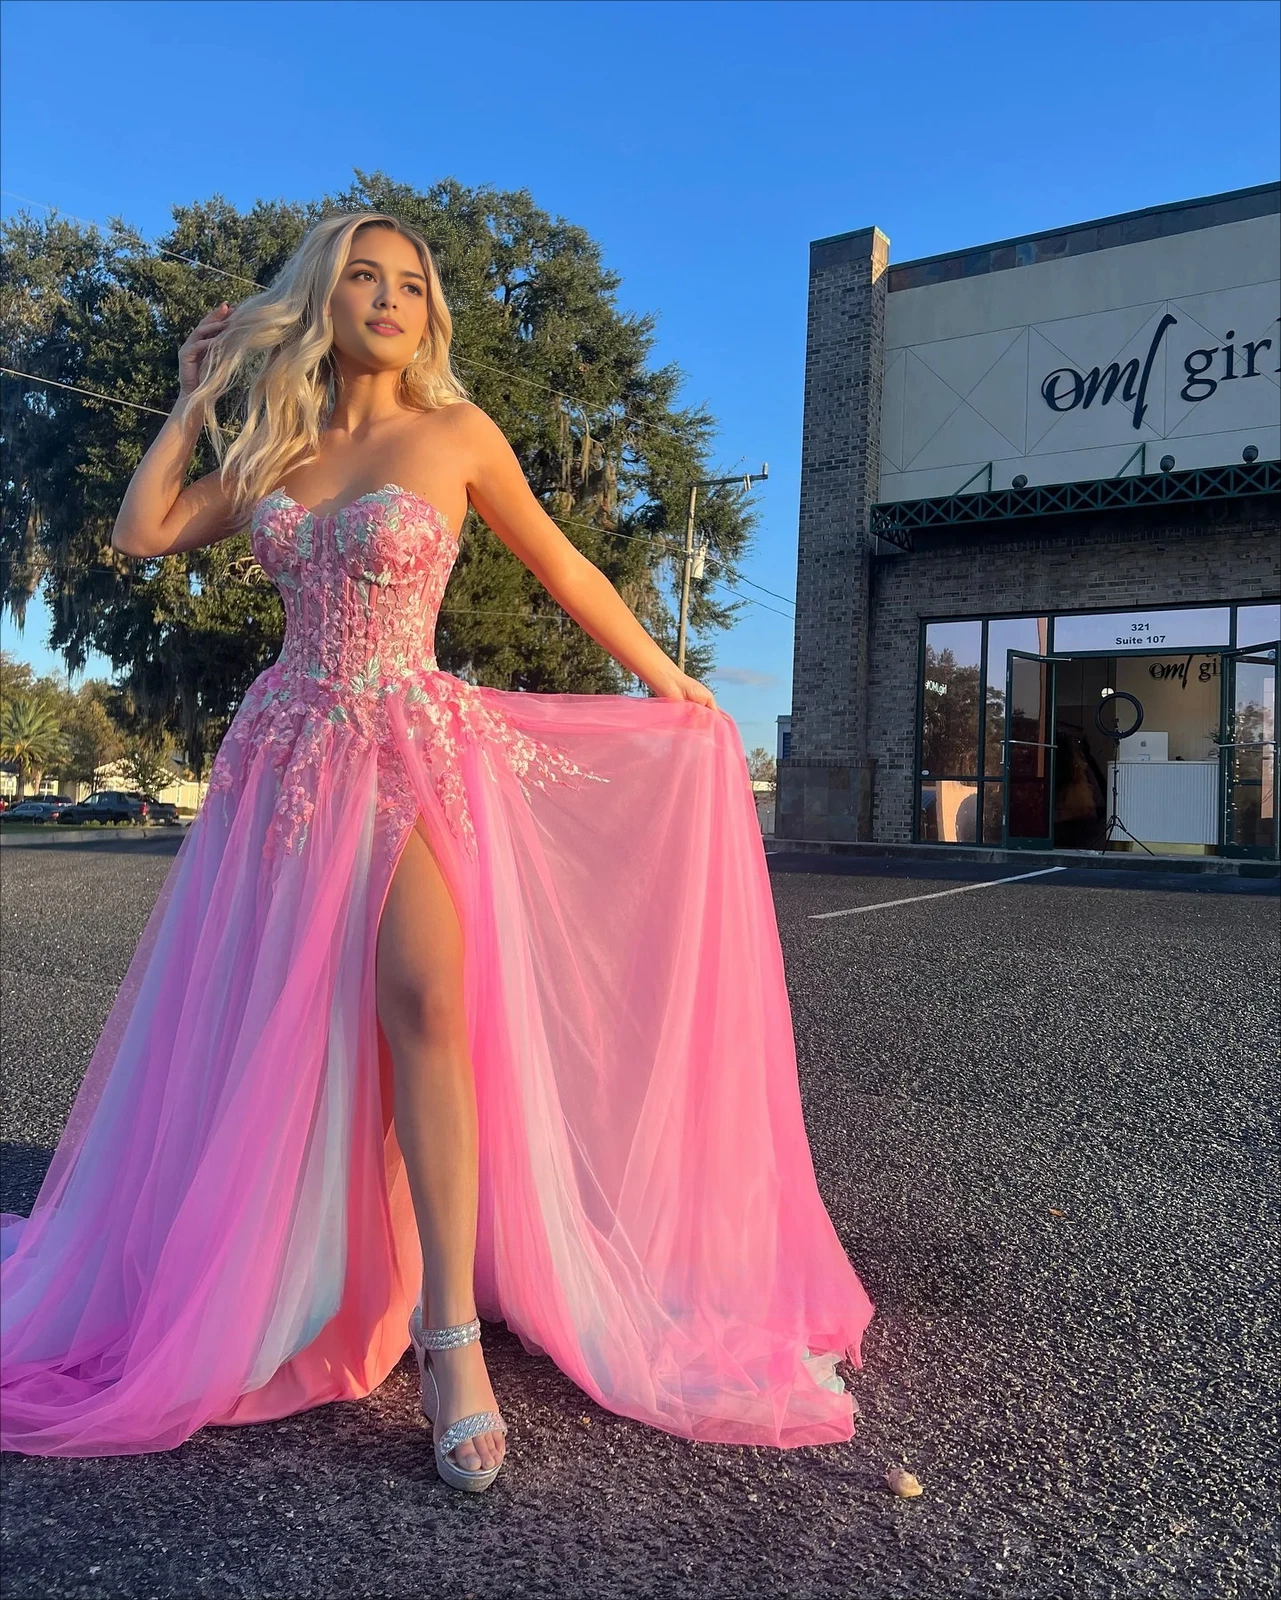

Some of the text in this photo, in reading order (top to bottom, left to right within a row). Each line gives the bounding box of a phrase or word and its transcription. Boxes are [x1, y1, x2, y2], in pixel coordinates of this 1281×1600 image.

[1131, 623, 1150, 632] 321
[1115, 635, 1166, 645] Suite 107
